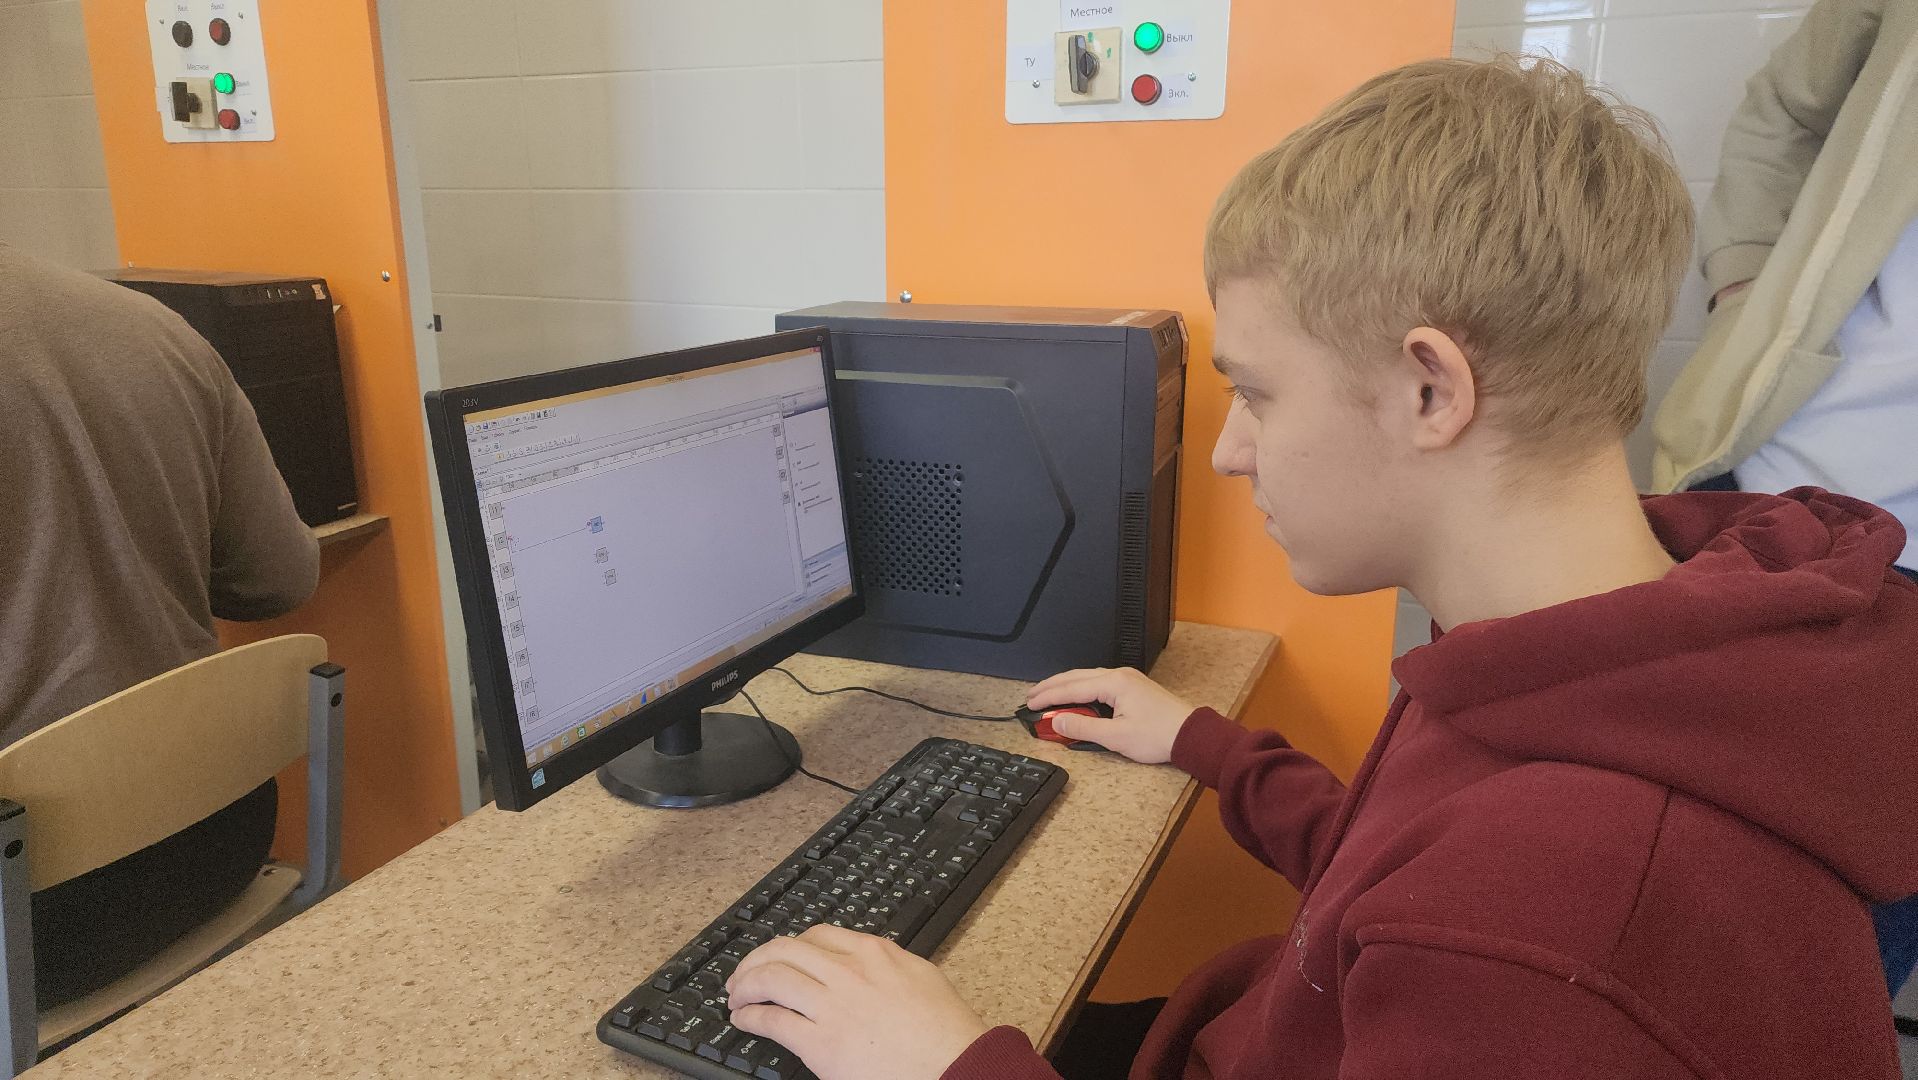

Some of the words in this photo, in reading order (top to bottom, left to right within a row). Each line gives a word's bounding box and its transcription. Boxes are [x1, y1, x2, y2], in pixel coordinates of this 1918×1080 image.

[1070, 6, 1113, 18] Местное
[1166, 33, 1193, 43] Выкл
[711, 670, 739, 692] PHILIPS
